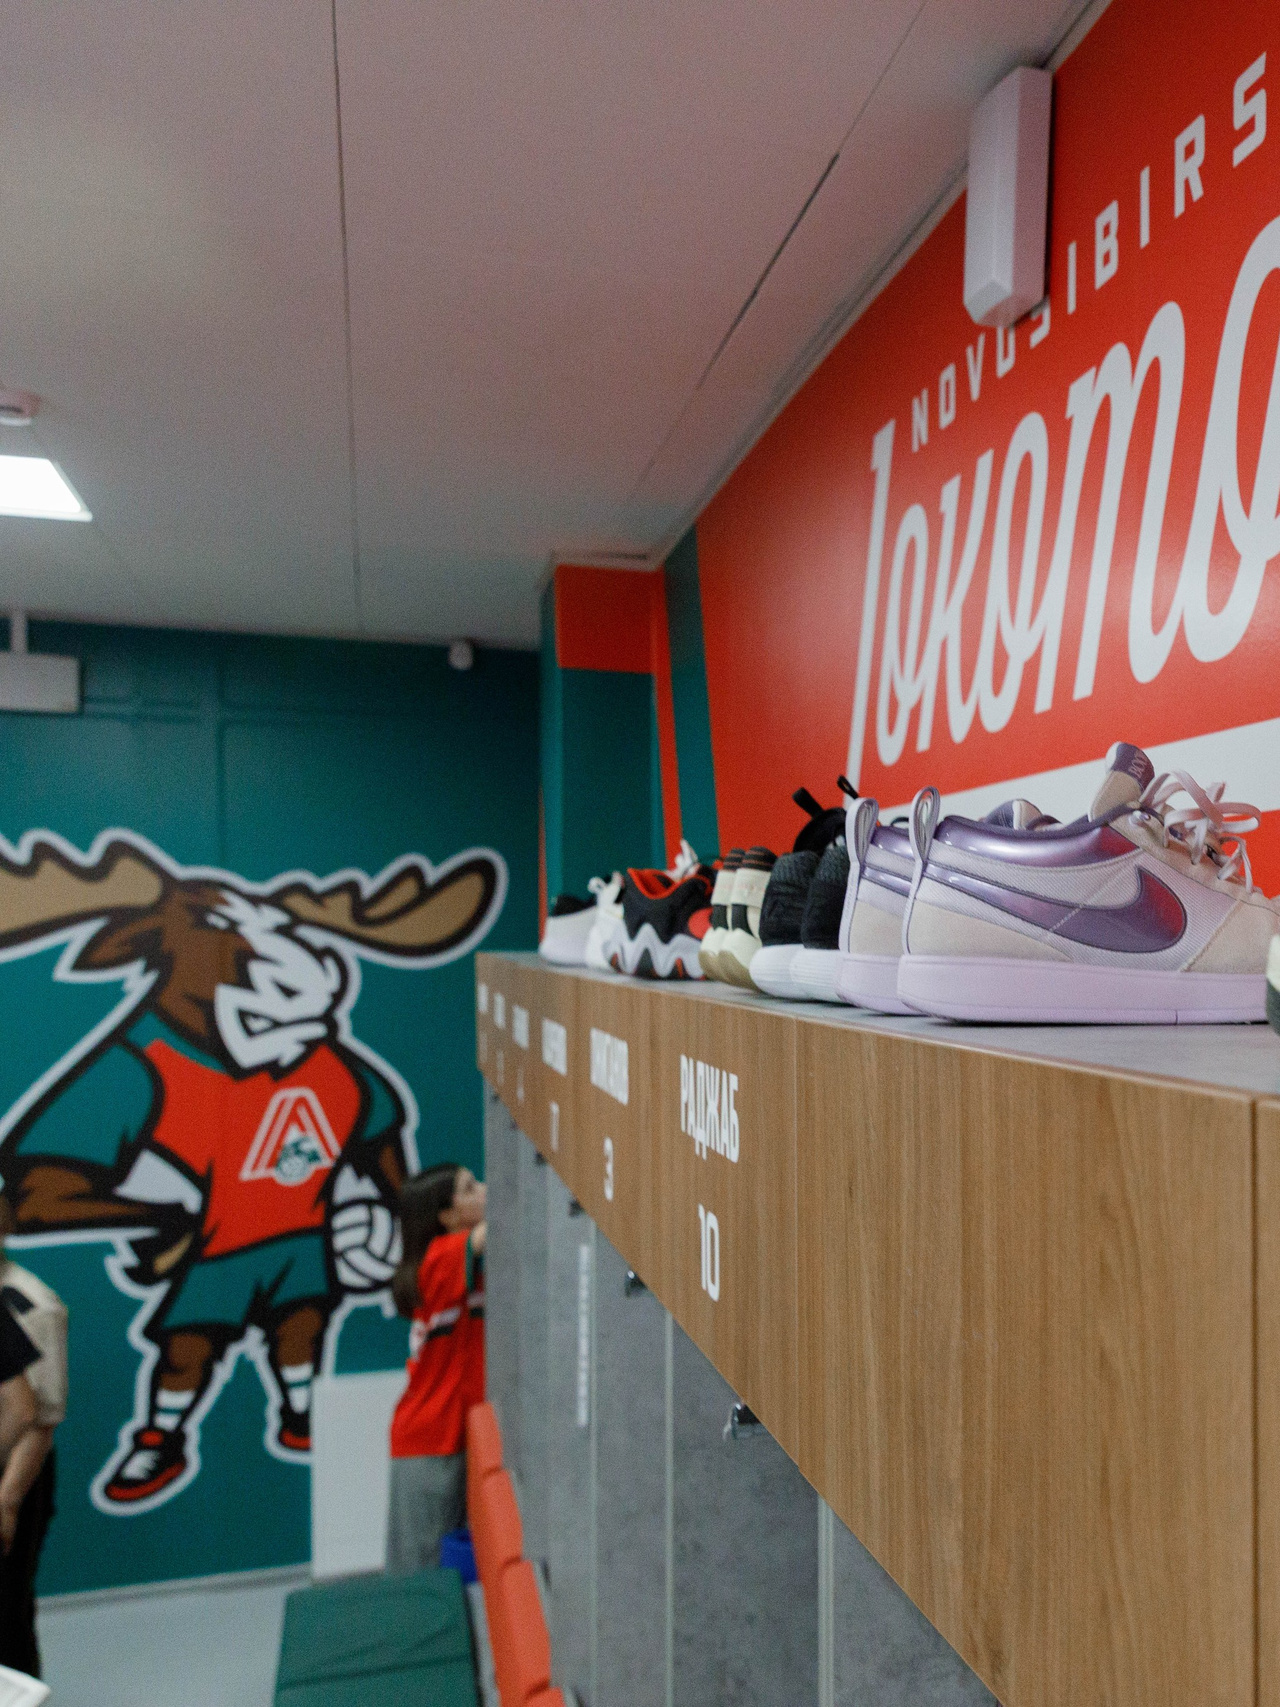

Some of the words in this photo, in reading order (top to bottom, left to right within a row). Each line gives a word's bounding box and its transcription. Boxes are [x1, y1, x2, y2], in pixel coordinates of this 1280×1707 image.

[680, 1053, 739, 1163] РАДЖАБ
[603, 1136, 613, 1201] 3
[698, 1203, 720, 1301] 10
